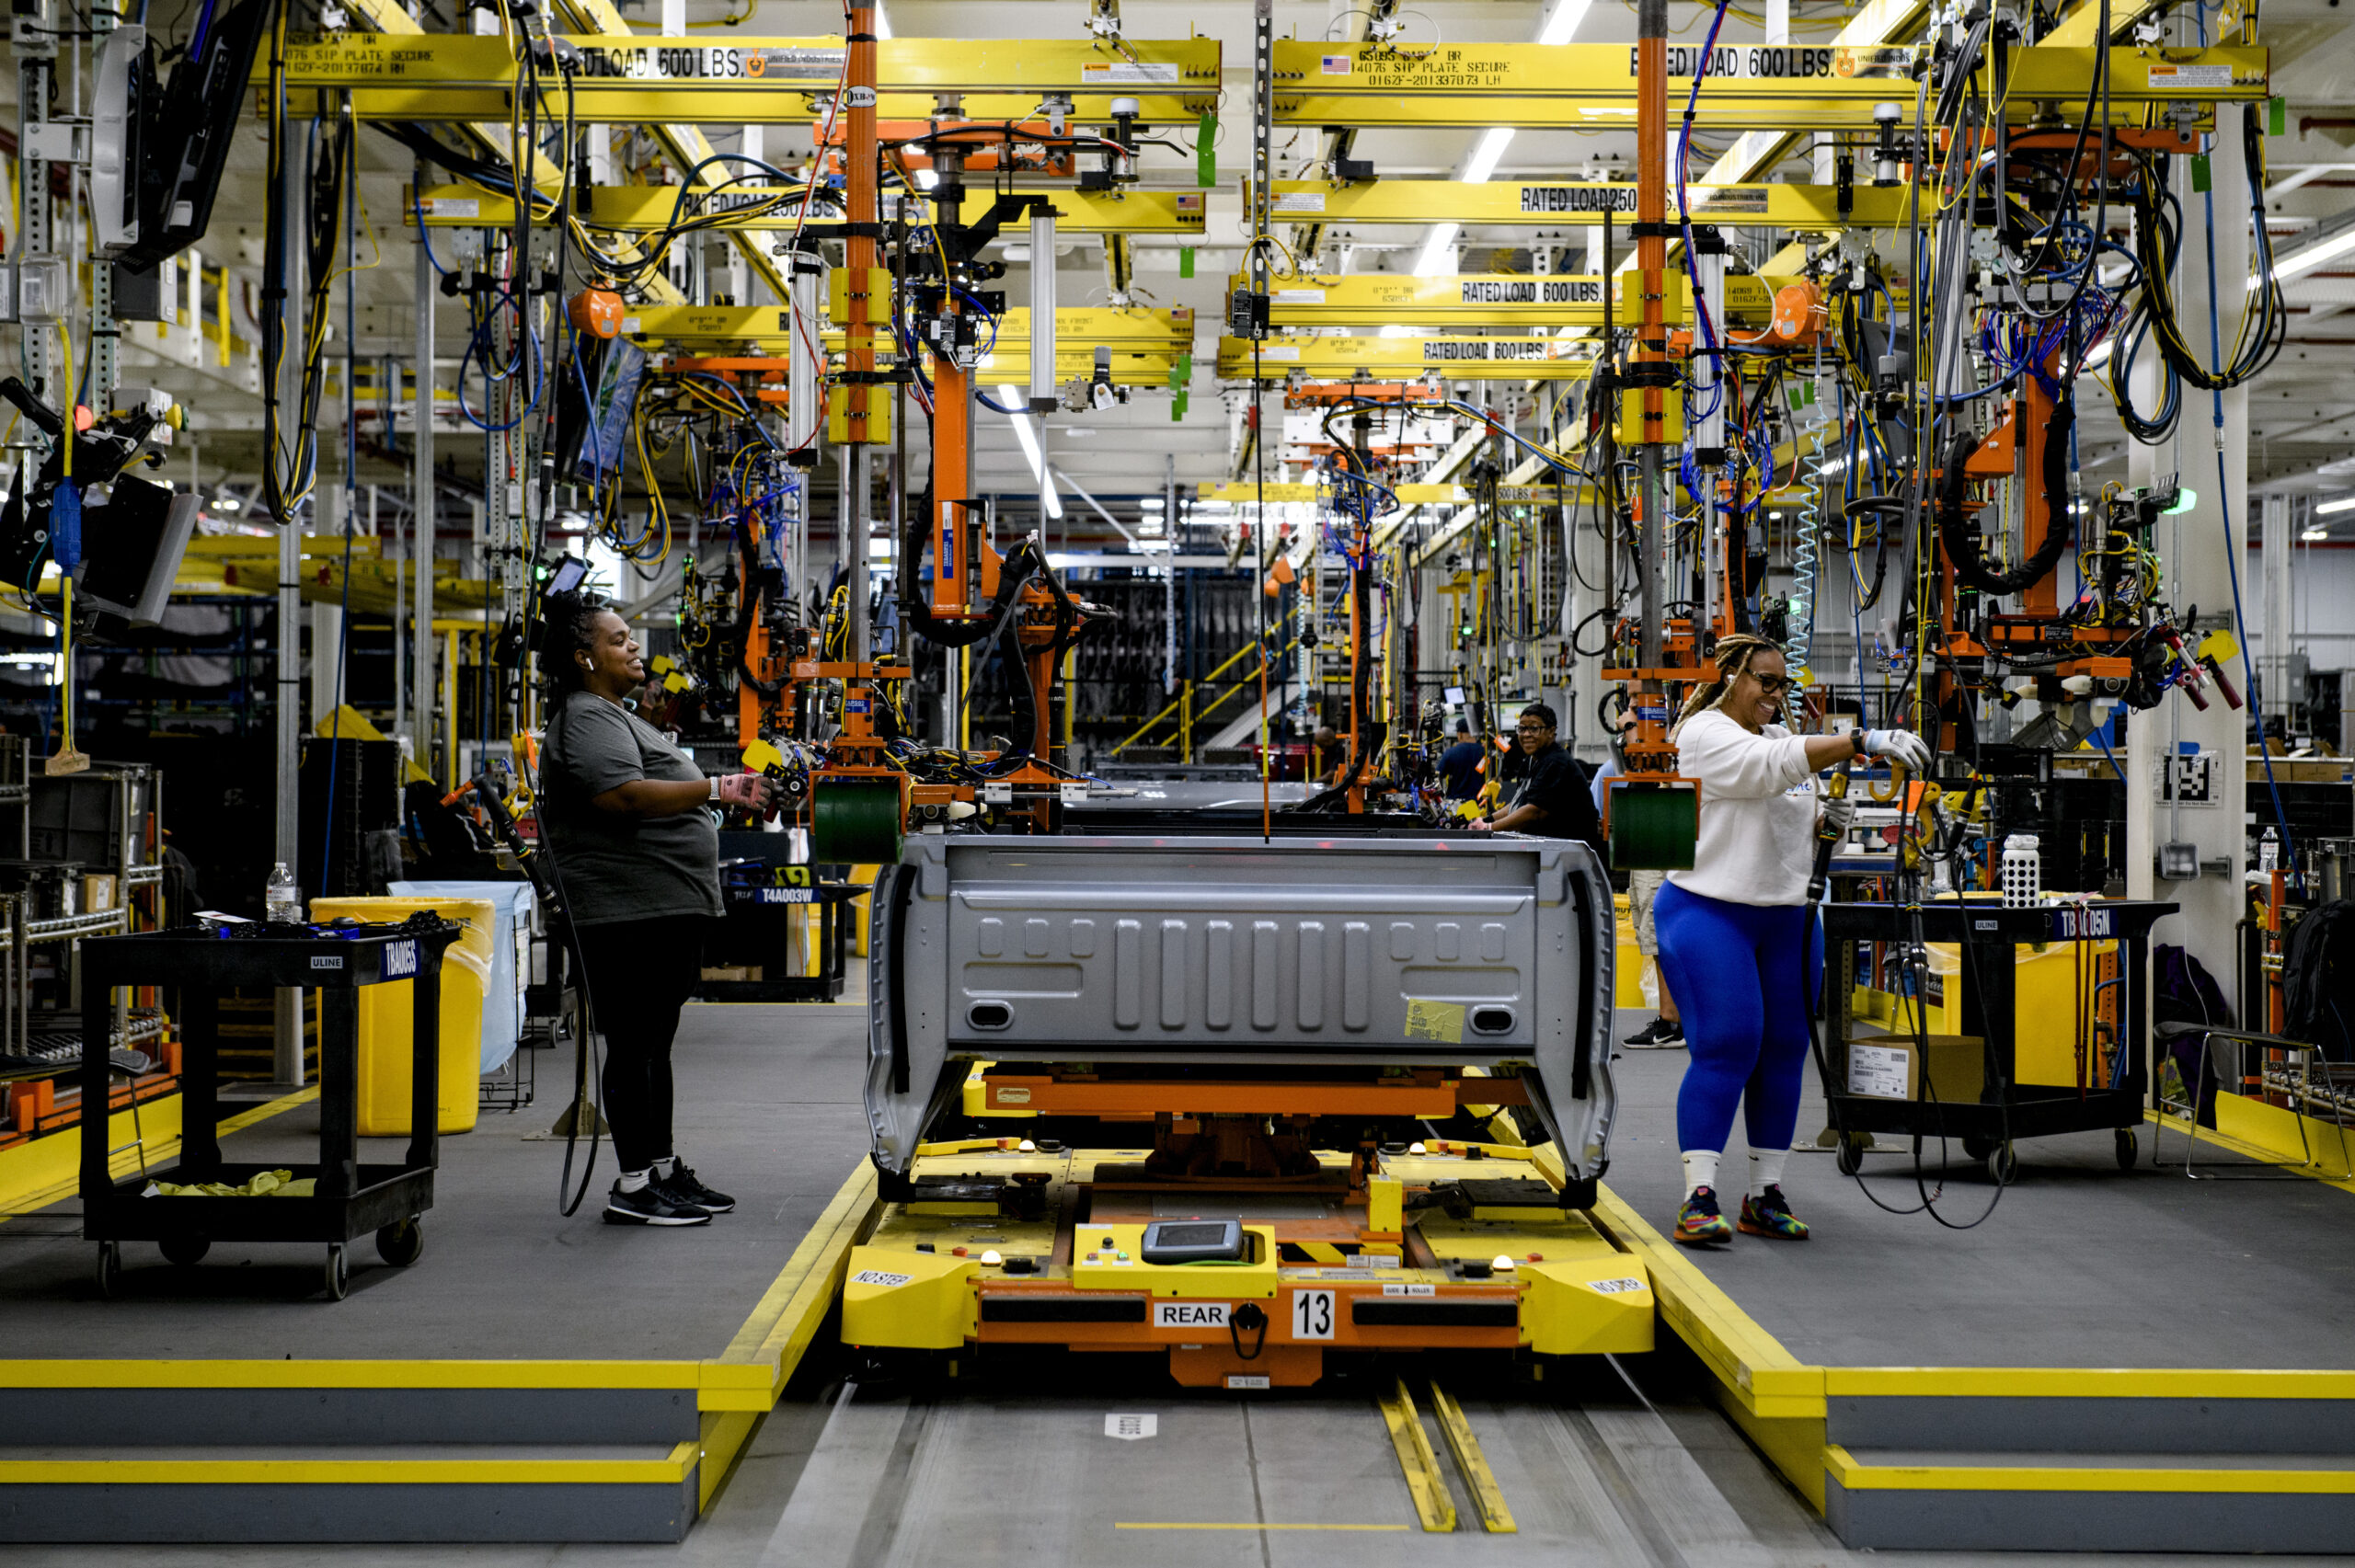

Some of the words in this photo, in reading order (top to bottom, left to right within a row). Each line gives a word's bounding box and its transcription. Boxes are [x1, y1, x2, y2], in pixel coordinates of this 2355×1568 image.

[345, 50, 385, 61] PLATE
[390, 50, 434, 62] SECURE
[602, 49, 646, 76] LOAD
[659, 49, 692, 76] 600
[699, 49, 745, 78] LBS.
[1749, 49, 1784, 76] 600
[1789, 49, 1834, 78] LBS.
[1393, 62, 1416, 74] SIP
[1422, 62, 1459, 74] PLATE
[1467, 62, 1511, 74] SECURE
[1486, 74, 1501, 86] LH
[1522, 188, 1567, 212] RATED
[1571, 188, 1609, 212] LOAD
[1609, 189, 1637, 212] 250
[1463, 282, 1500, 302] RATED
[1504, 282, 1536, 302] LOAD
[1543, 282, 1570, 302] 600
[1571, 282, 1603, 303] LBS.
[1424, 342, 1458, 360] RATED
[1461, 342, 1488, 360] LOAD
[1494, 342, 1516, 360] 600
[1519, 342, 1547, 361] LBS.
[762, 887, 813, 902] T4A003W
[1977, 921, 1998, 930] ULINE
[313, 957, 341, 967] ULINE
[385, 939, 417, 977] TBA005S
[855, 1271, 879, 1282] NO
[873, 1273, 909, 1286] STEP
[1591, 1281, 1615, 1293] NO
[1163, 1307, 1223, 1323] REAR
[1298, 1293, 1330, 1334] 13
